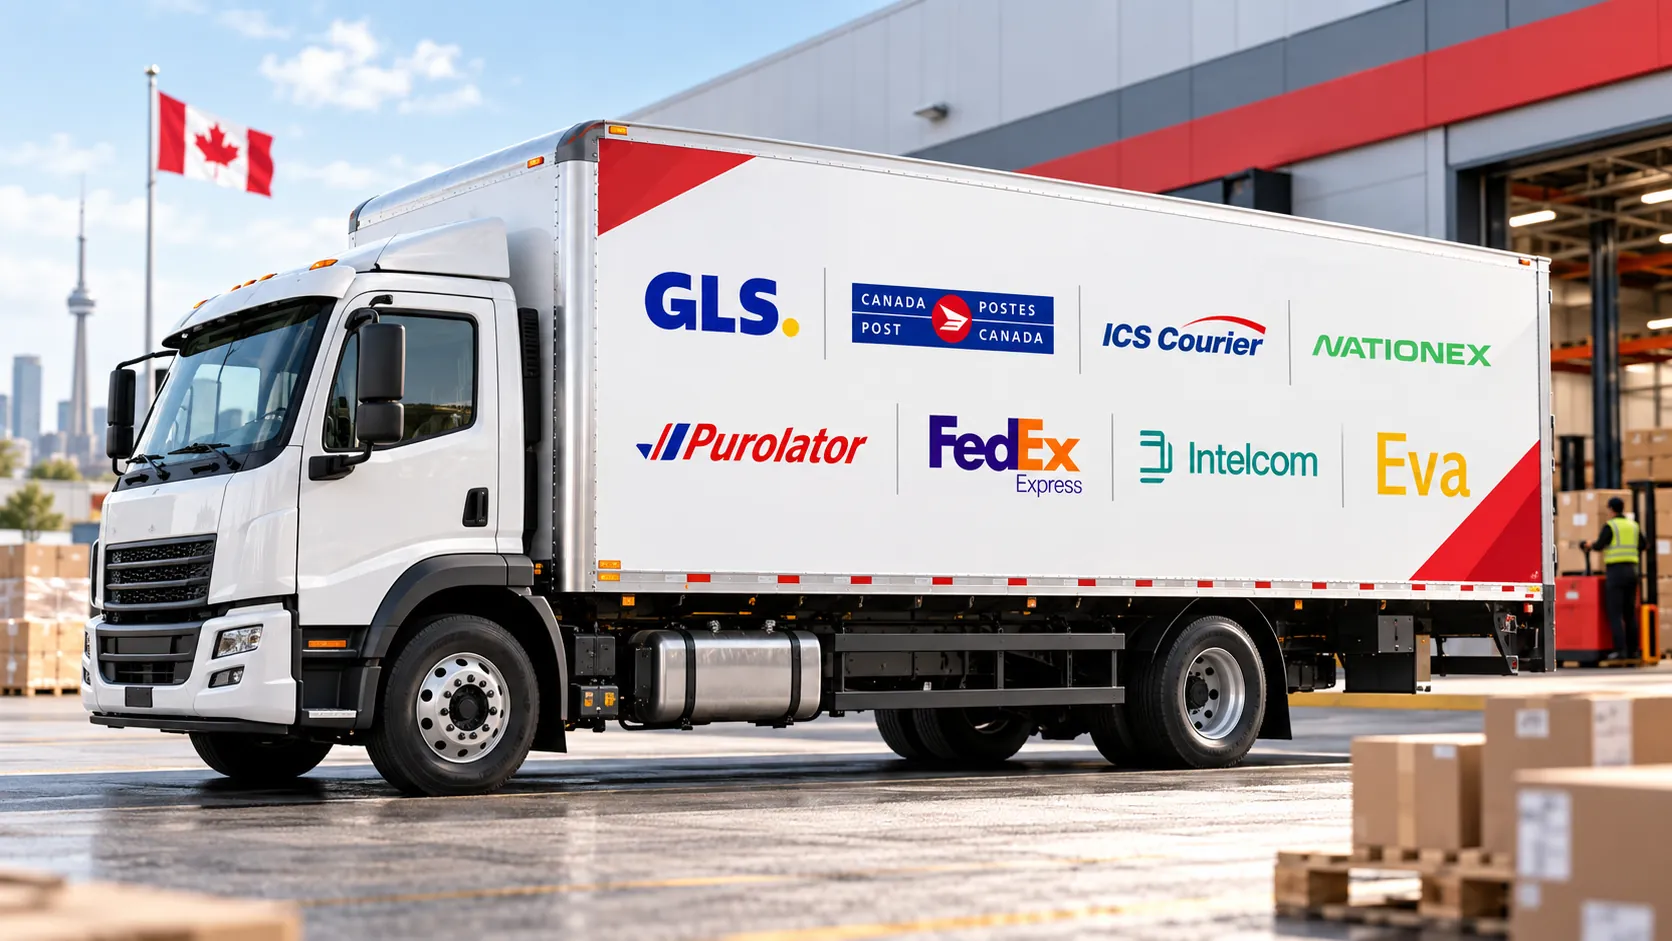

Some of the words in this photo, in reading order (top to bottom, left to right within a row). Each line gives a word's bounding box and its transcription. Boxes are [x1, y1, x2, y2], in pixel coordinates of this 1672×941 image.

[862, 294, 925, 308] CANADA
[980, 302, 1034, 315] POSTES
[863, 322, 900, 335] POST
[980, 329, 1042, 343] CANADA
[1103, 323, 1151, 348] ICS
[1158, 326, 1263, 356] Courier
[1312, 335, 1491, 366] NATIONEX
[683, 423, 868, 464] Purolator
[929, 415, 1080, 472] FedEx
[1190, 442, 1317, 476] Intelcom
[1377, 432, 1470, 497] Eva
[1017, 474, 1082, 497] Express
